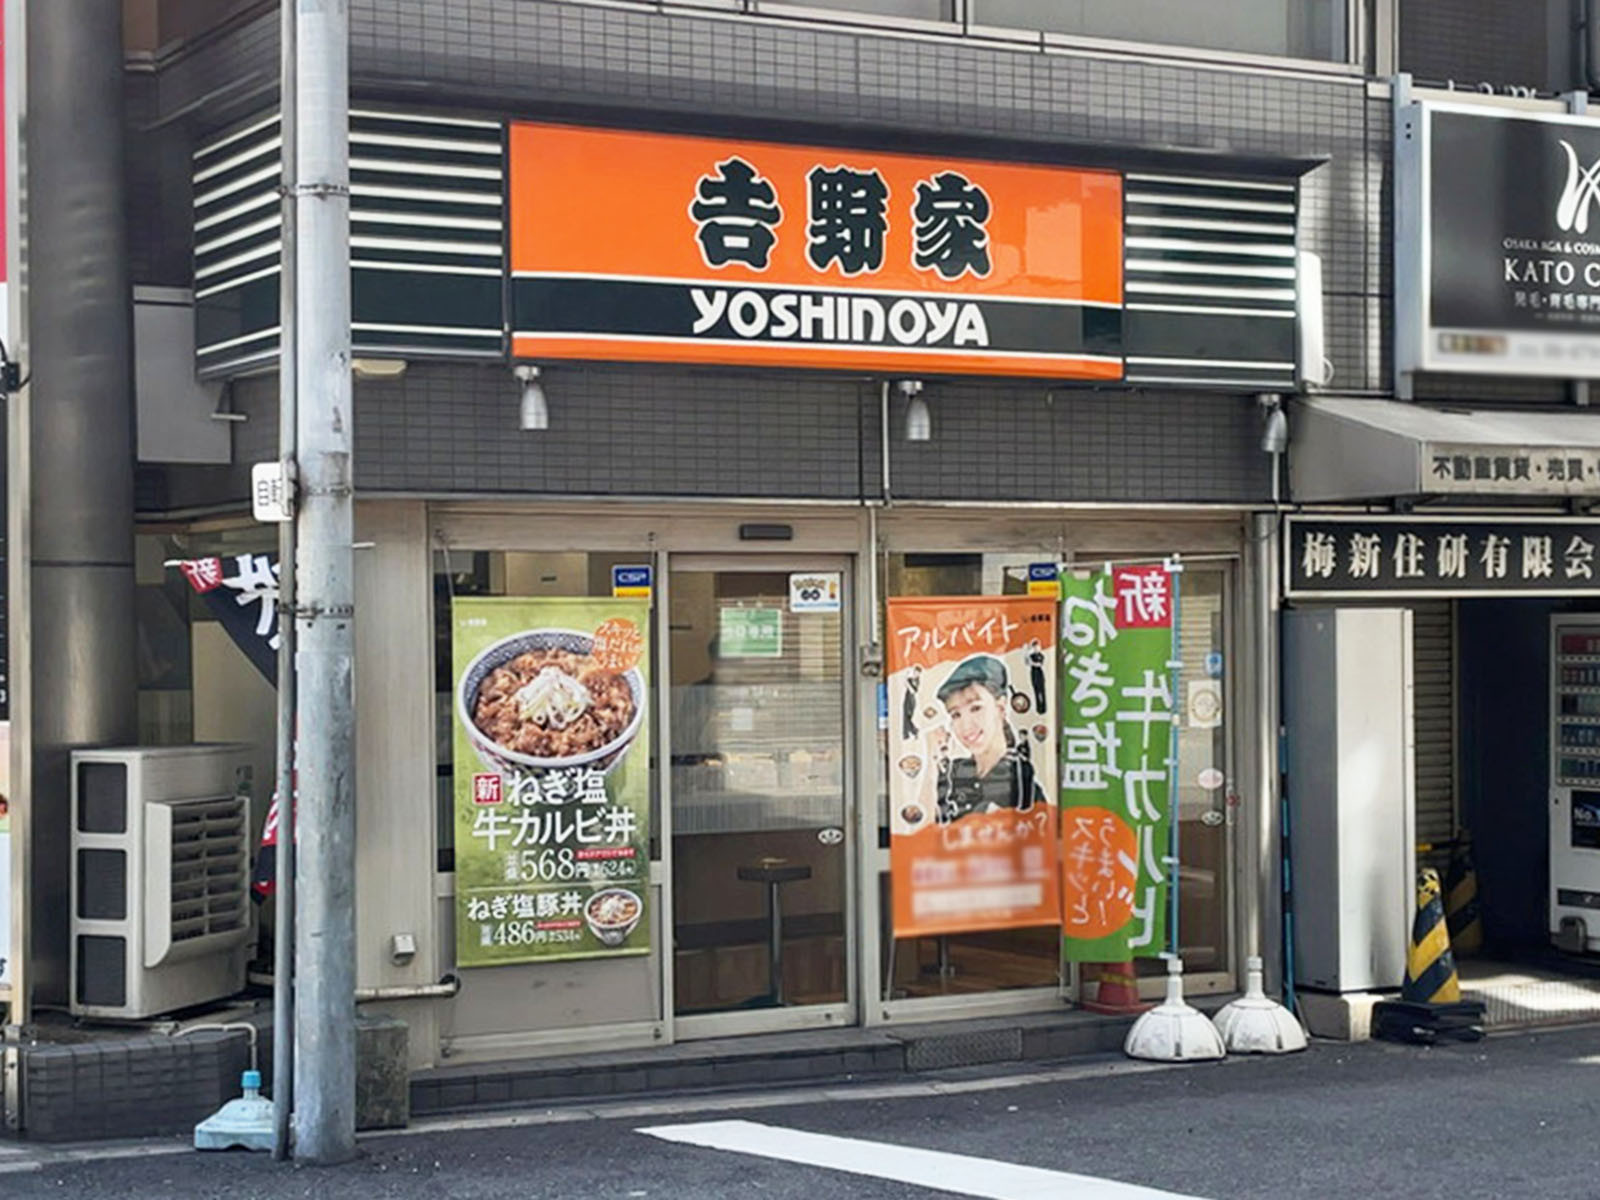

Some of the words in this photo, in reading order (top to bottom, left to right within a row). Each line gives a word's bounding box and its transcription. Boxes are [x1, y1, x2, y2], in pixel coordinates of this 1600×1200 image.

[689, 155, 994, 281] 吉野家
[1504, 258, 1575, 285] KATO
[690, 289, 989, 346] YOSHINOYA
[1303, 531, 1595, 579] 梅新住研有限会
[897, 614, 1019, 658] アルバイト
[475, 776, 501, 802] 新
[507, 768, 608, 806] ねぎ塩
[472, 806, 636, 850] 牛カルビ丼
